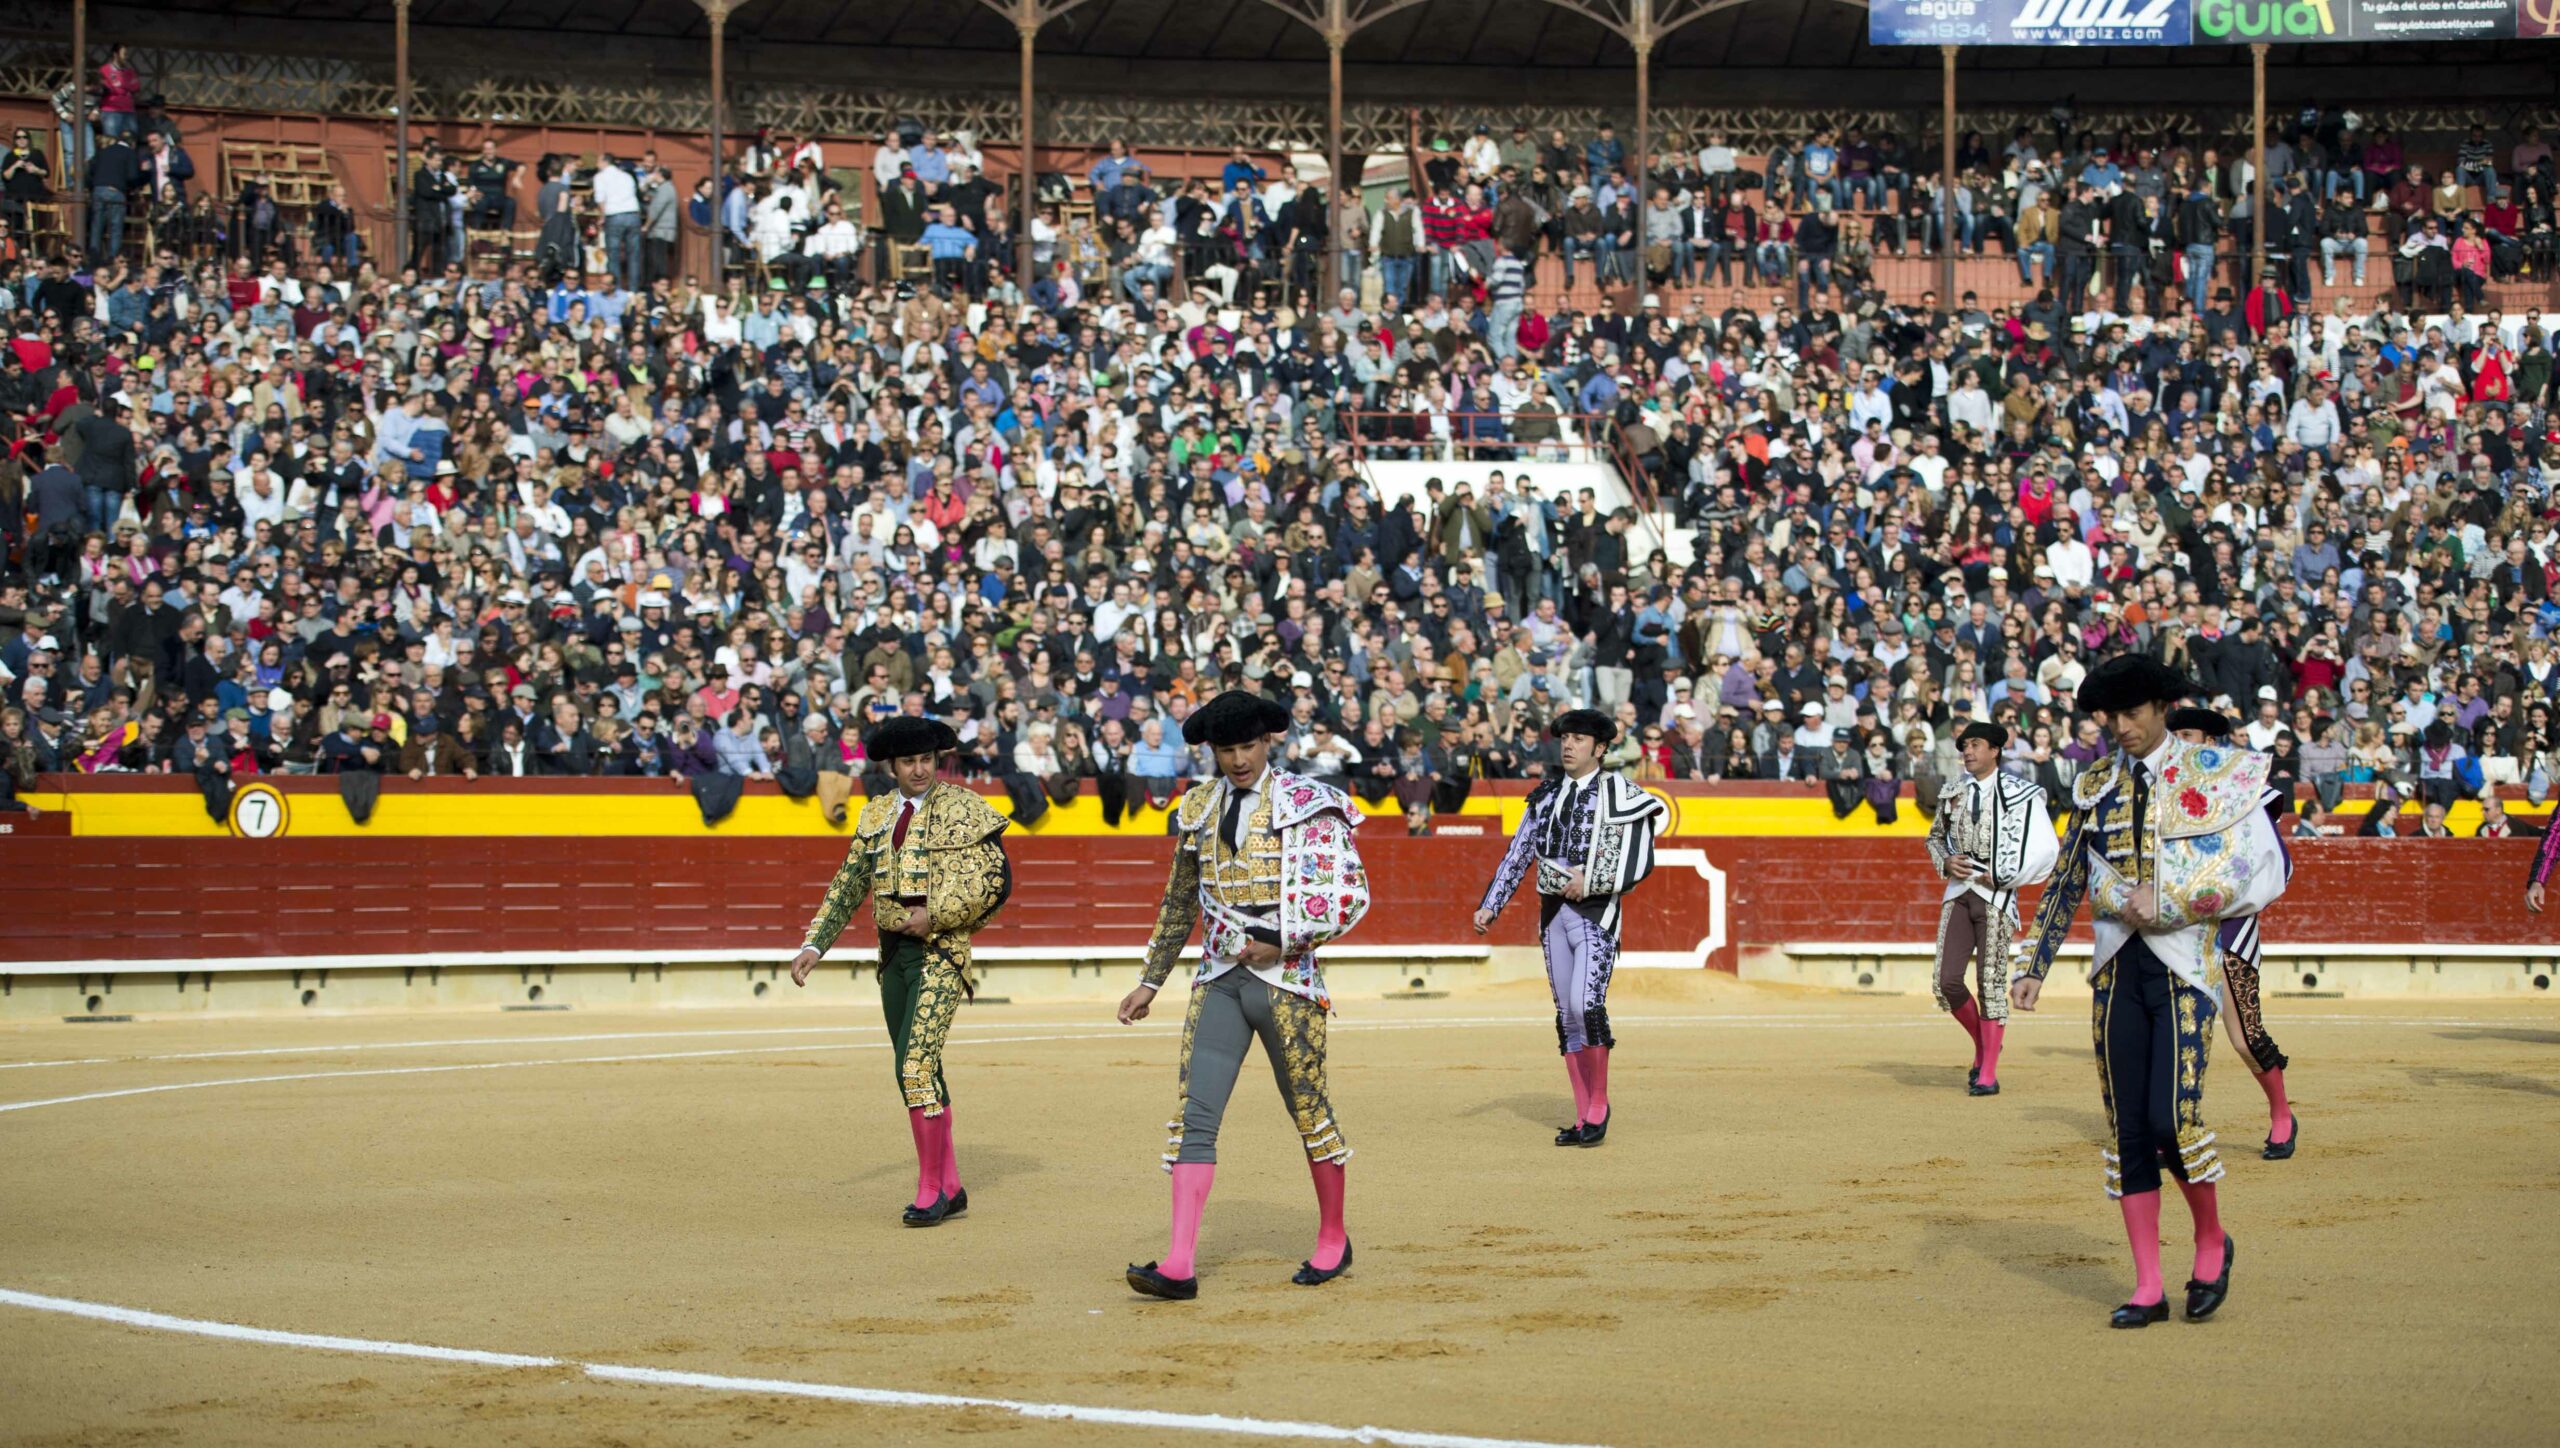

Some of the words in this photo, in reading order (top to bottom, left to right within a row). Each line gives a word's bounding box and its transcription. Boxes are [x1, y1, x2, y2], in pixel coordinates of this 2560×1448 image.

[1920, 1, 1976, 20] agua
[2362, 2, 2375, 12] Tu
[2401, 1, 2418, 11] del
[2419, 1, 2441, 10] ocio
[2442, 2, 2455, 10] en
[1929, 22, 1988, 39] 1934
[249, 799, 267, 830] 7
